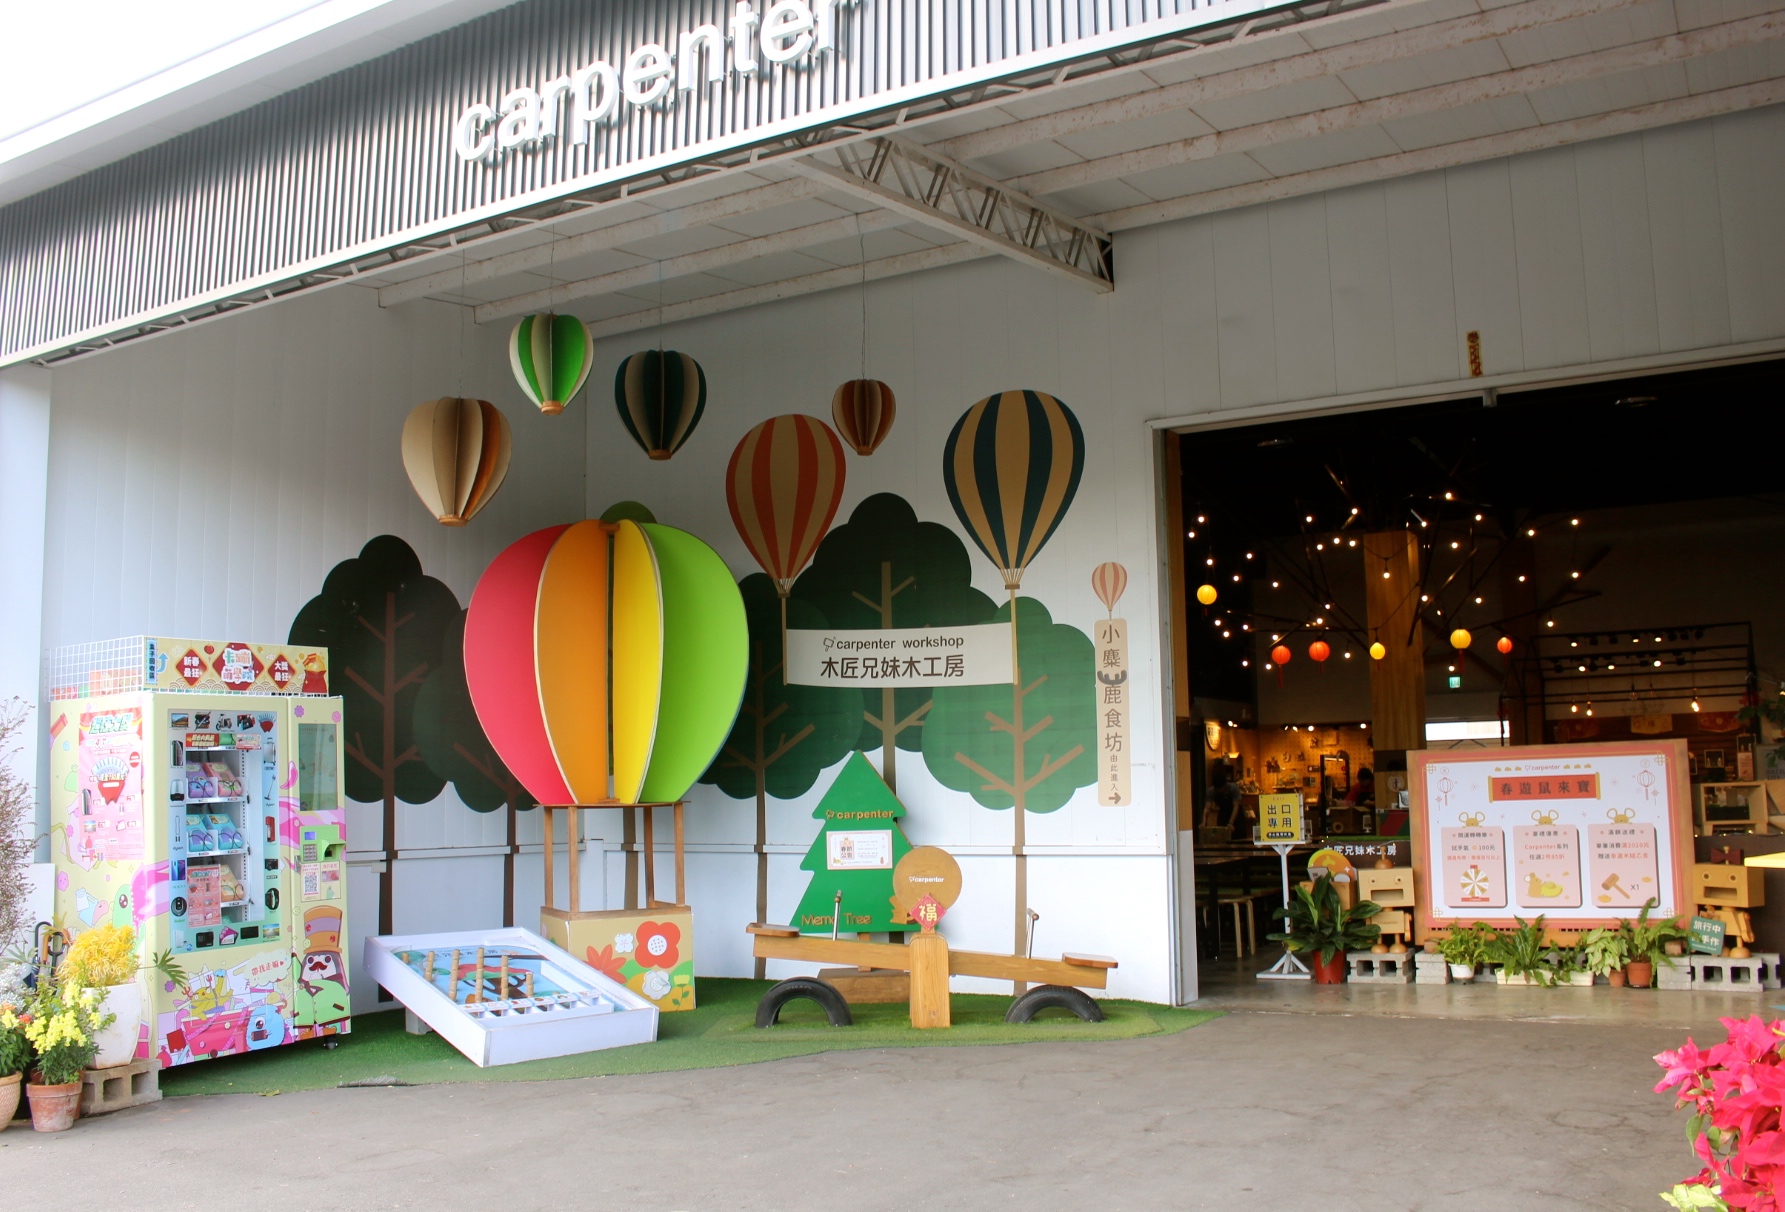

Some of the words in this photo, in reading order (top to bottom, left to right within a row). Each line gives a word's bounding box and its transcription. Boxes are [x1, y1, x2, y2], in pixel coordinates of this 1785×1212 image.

[456, 0, 840, 162] carpenter
[836, 637, 896, 652] carpenter
[902, 635, 964, 649] workshop
[183, 656, 200, 667] 新春
[274, 661, 289, 671] 大獎
[820, 654, 965, 679] 木匠兄妹木工房
[183, 668, 200, 678] 最狂
[274, 672, 289, 682] 最狂
[1109, 754, 1119, 791] 由此進入
[1531, 763, 1561, 772] carpenter
[1501, 780, 1590, 796] 春遊鼠來寶
[836, 809, 894, 821] carpenter
[1267, 804, 1292, 815] 出口
[1267, 817, 1292, 828] 專用
[844, 912, 872, 925] Tree
[918, 903, 938, 922] 福
[1693, 920, 1721, 934] 旅行中
